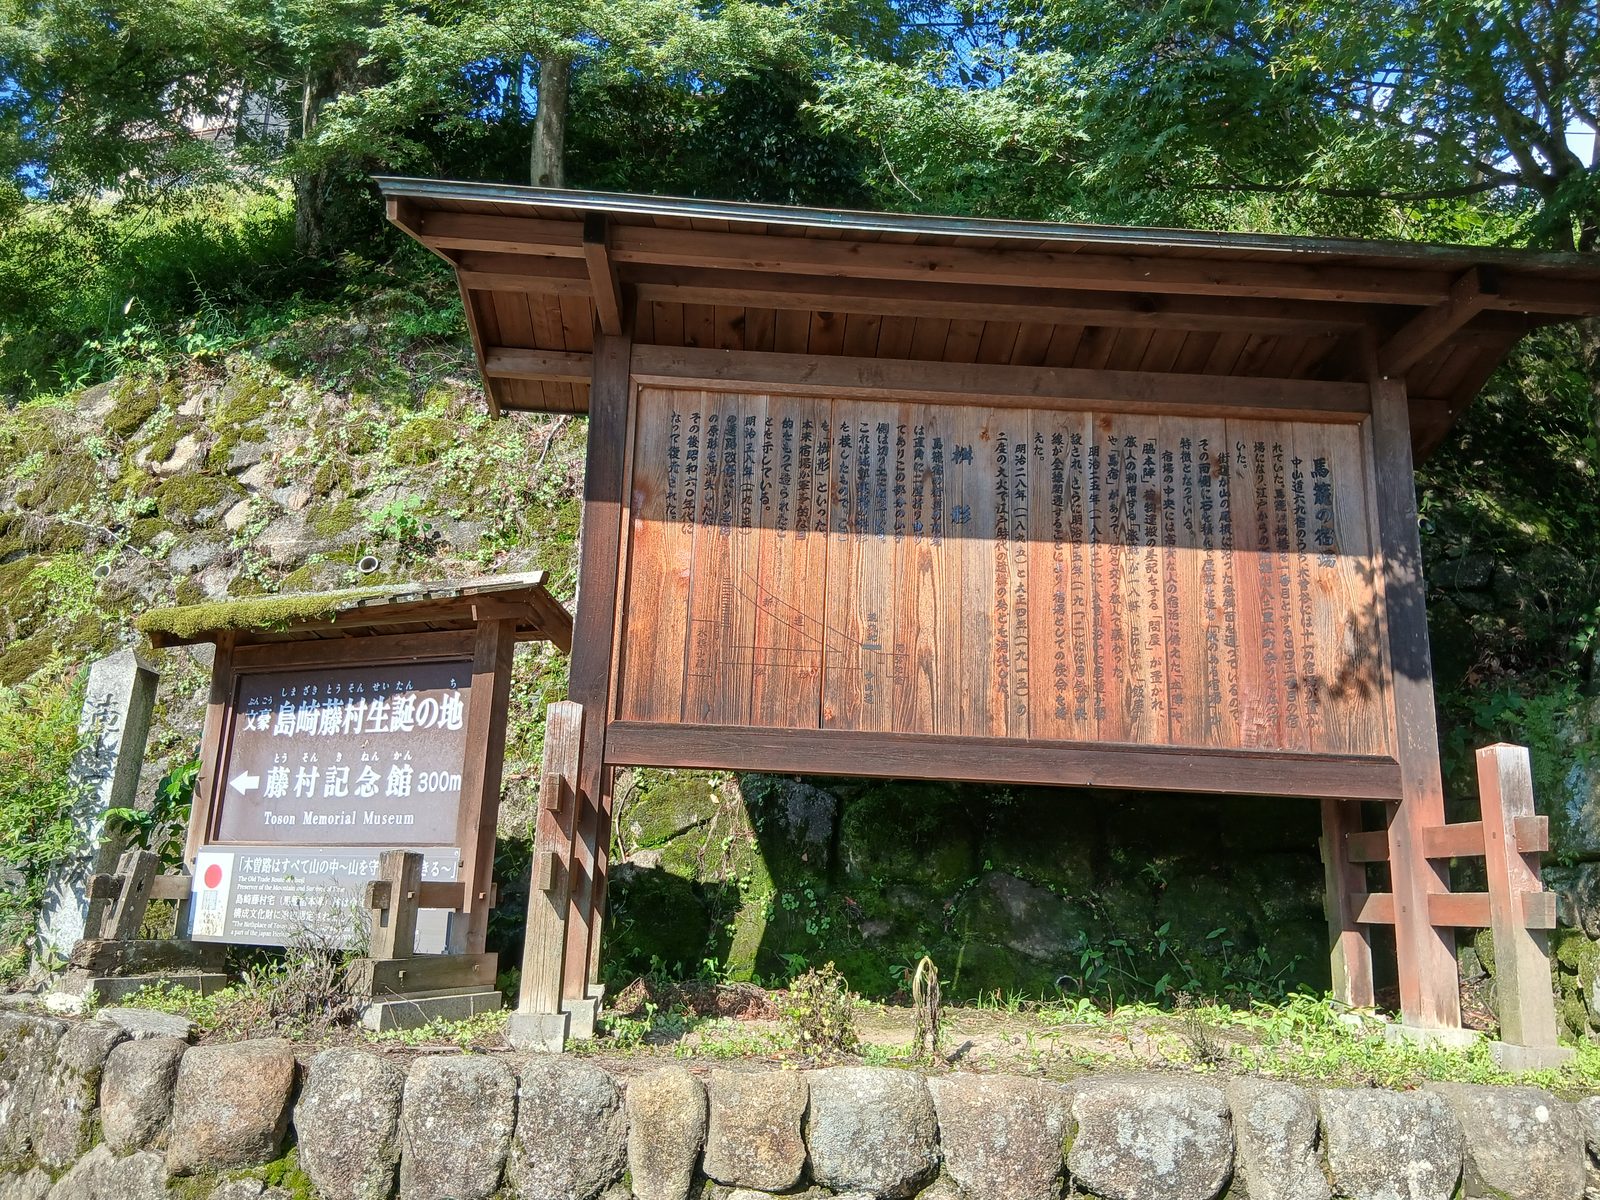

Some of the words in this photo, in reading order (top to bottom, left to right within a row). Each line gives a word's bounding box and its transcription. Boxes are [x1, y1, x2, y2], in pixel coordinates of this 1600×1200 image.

[1180, 438, 1194, 535] 特徴となっている。
[243, 708, 272, 731] 文豪
[263, 763, 414, 798] 藤村記念館
[417, 770, 462, 793] 300m
[264, 811, 296, 825] Toson
[302, 810, 356, 825] Memorial
[363, 810, 414, 825] Museum
